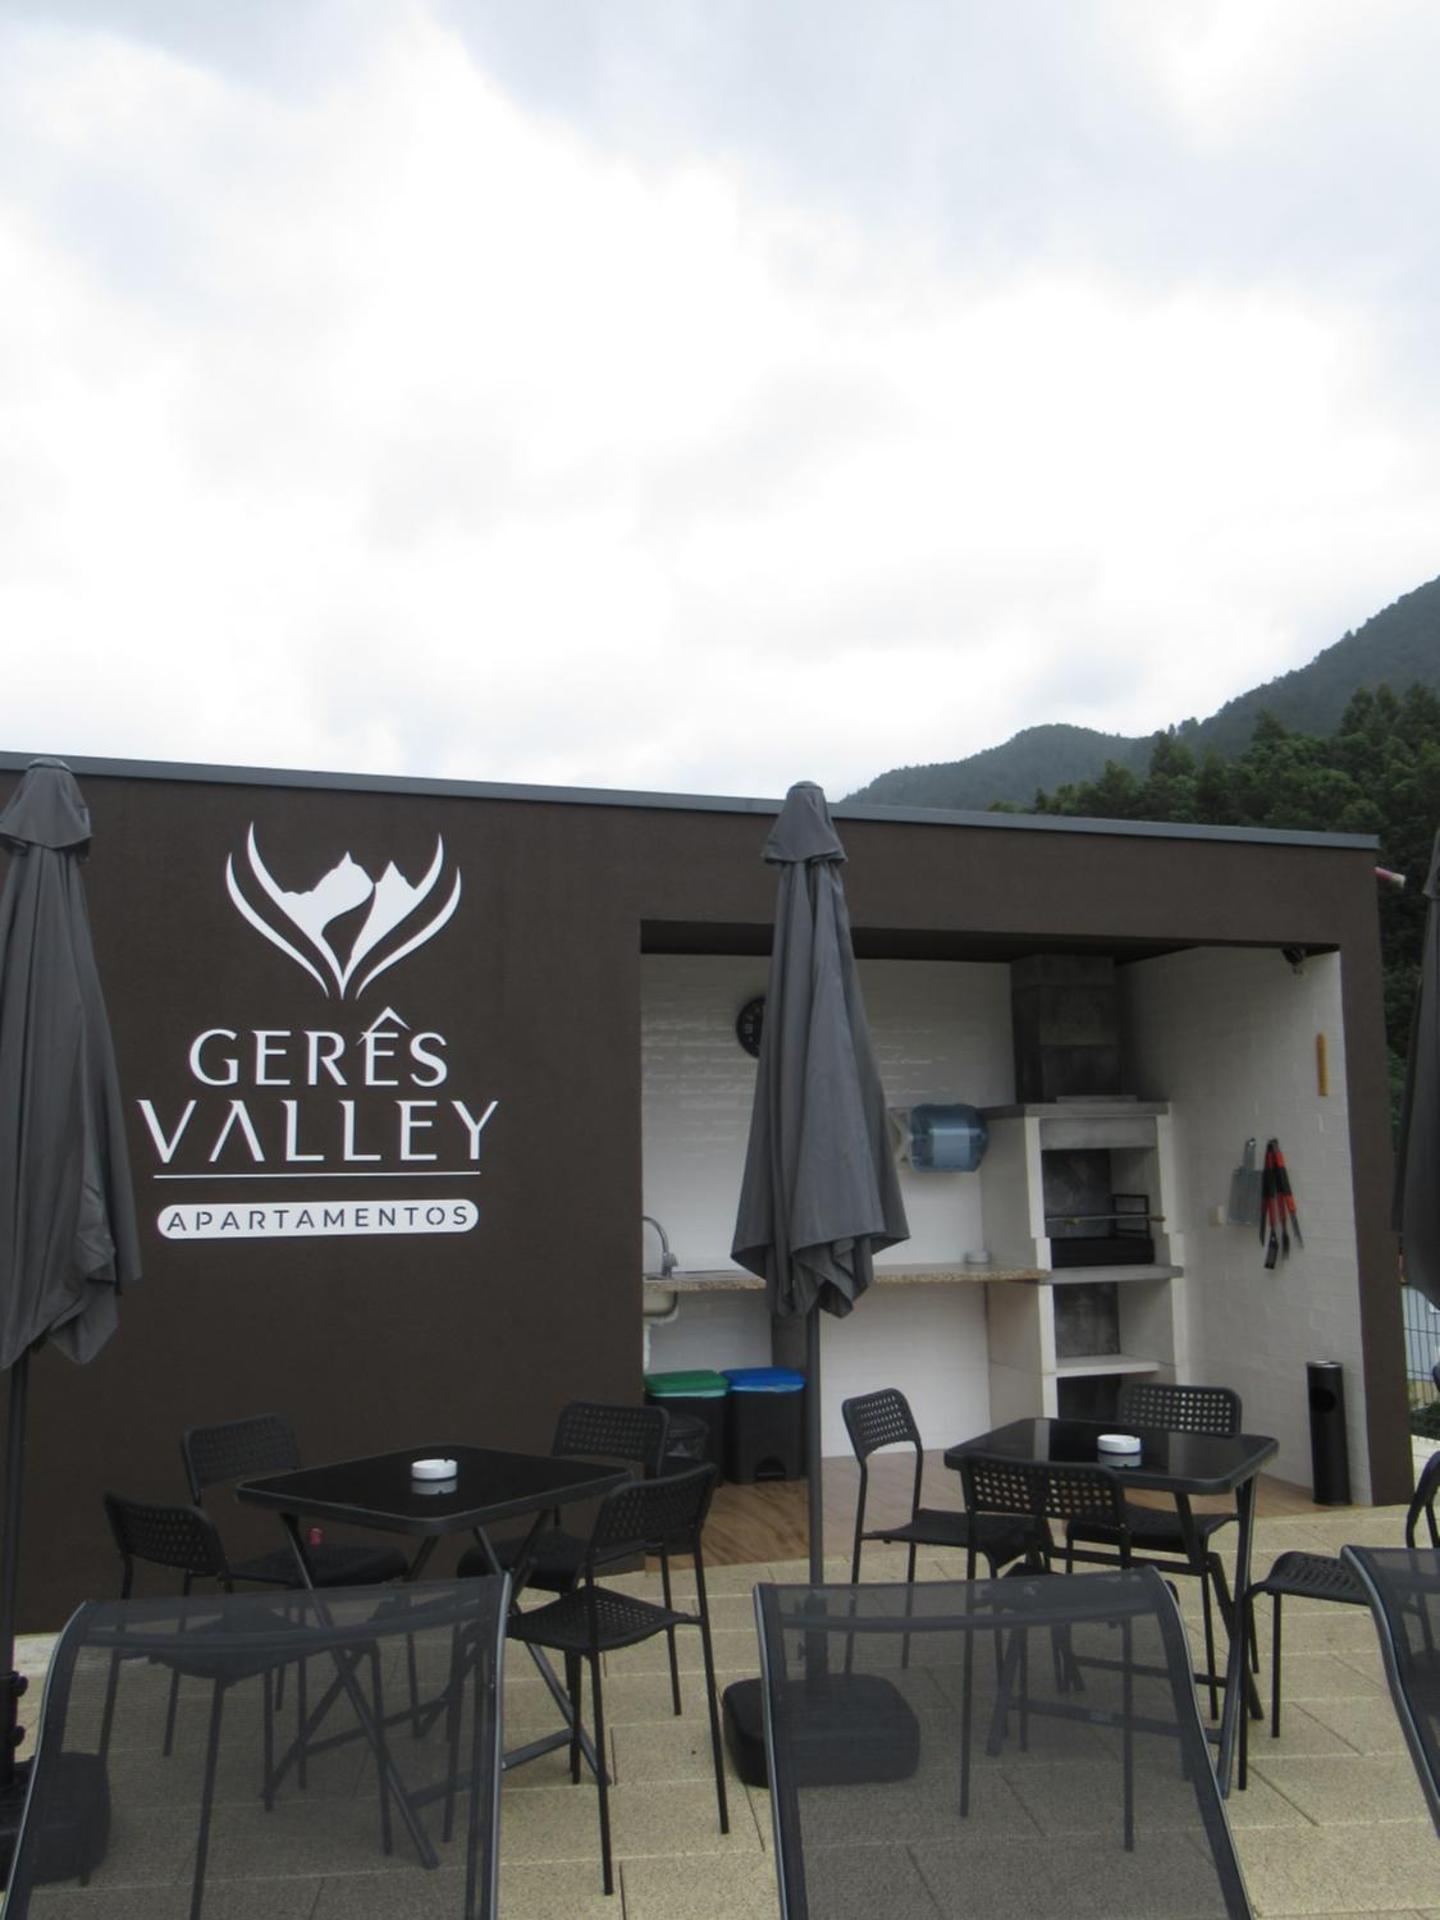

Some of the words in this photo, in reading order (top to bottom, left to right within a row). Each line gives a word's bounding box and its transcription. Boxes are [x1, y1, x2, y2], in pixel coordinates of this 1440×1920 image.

[189, 1006, 448, 1086] GERÊS
[137, 1099, 499, 1163] VALLEY
[166, 1205, 470, 1232] APARTAMENTOS
